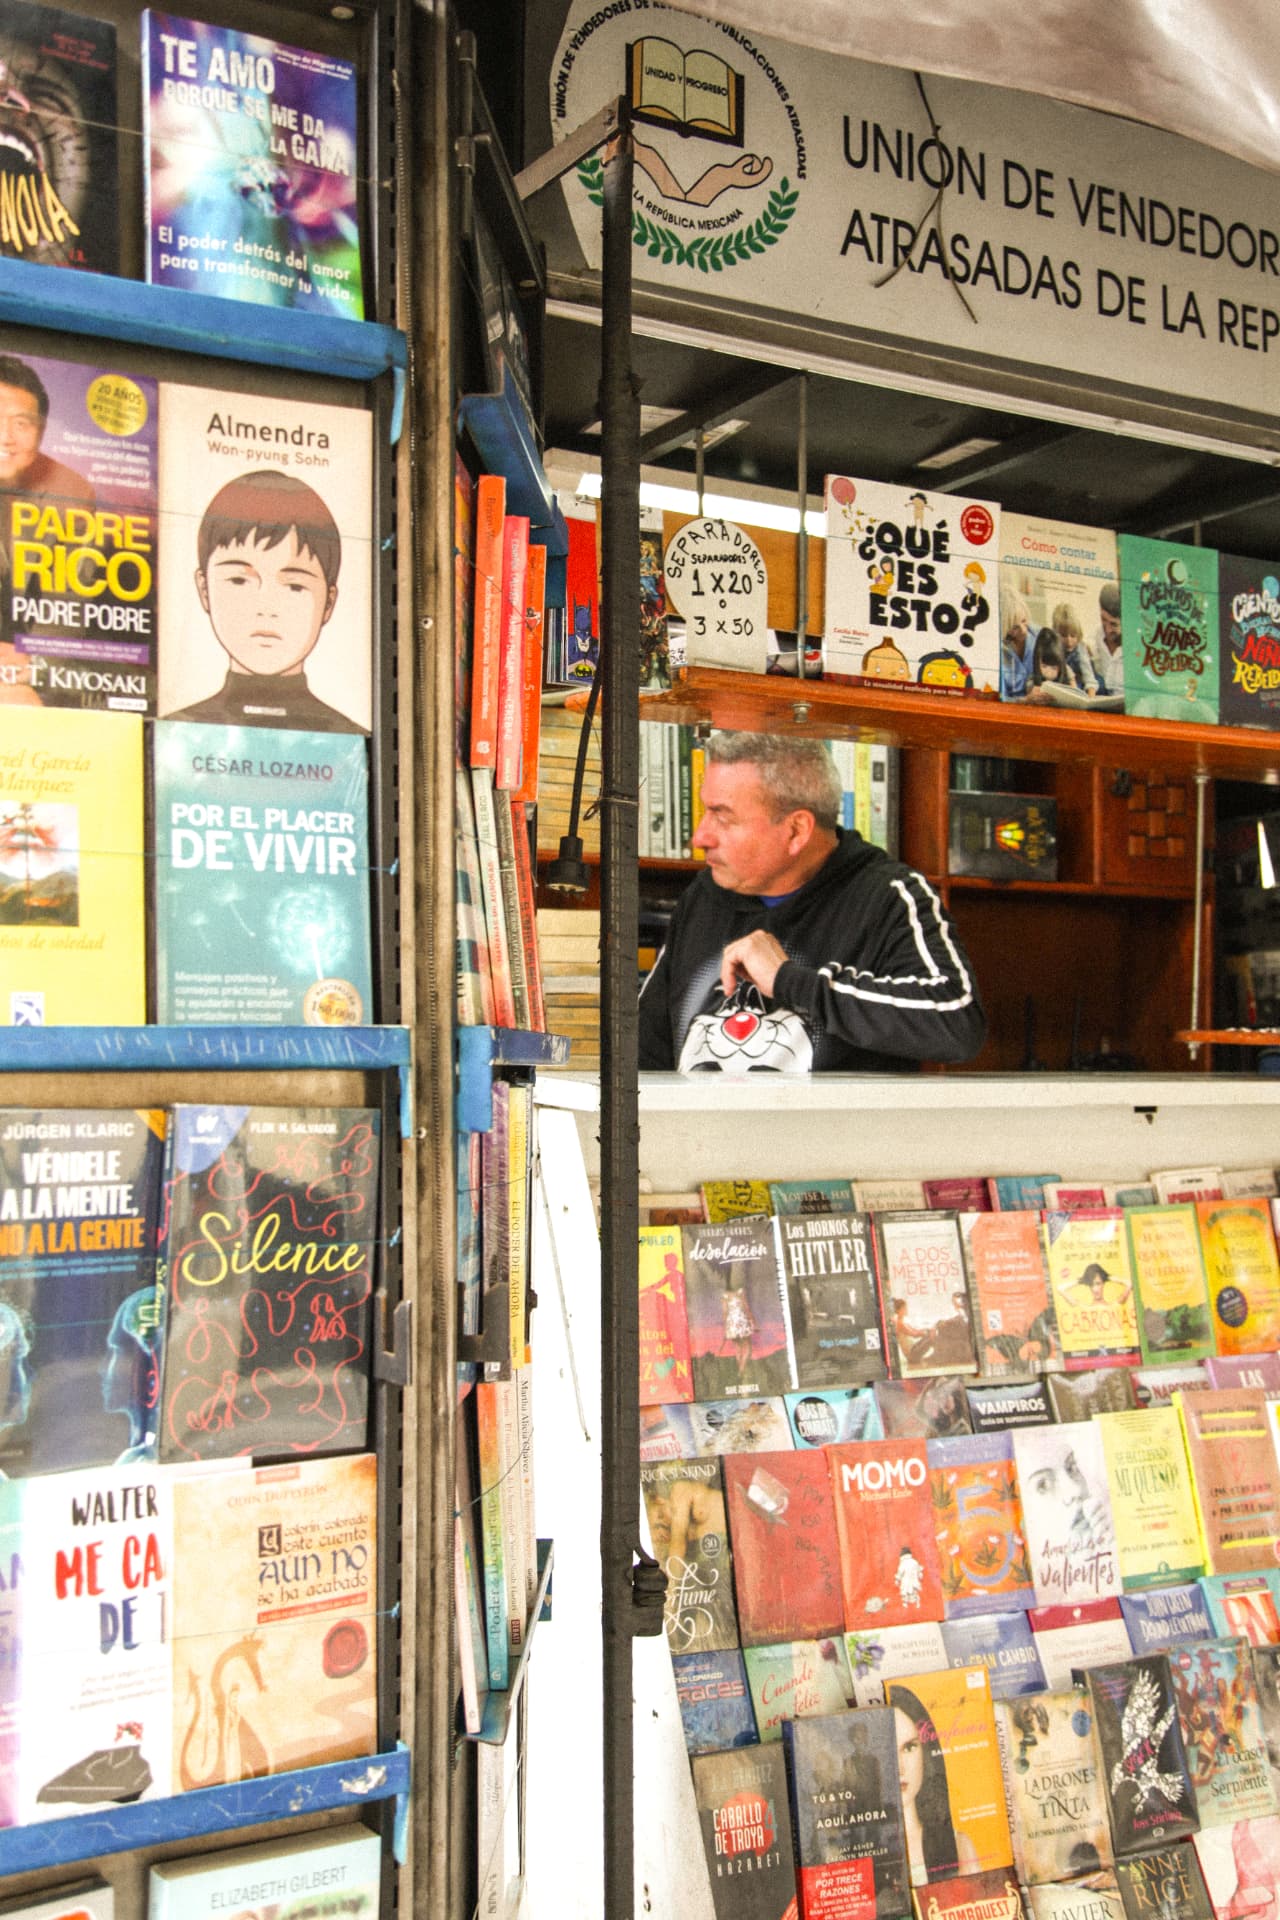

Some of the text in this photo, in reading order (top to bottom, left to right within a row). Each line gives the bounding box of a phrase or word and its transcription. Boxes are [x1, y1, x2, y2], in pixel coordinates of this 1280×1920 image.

[159, 33, 198, 78] TE
[207, 47, 276, 95] AMO
[555, 0, 632, 119] UNIÓN DE VENDEDORES
[644, 66, 676, 83] UNIDAD
[686, 77, 729, 97] PROGRESO
[162, 77, 325, 140] PORQUE SE ME DA
[269, 135, 288, 157] LA
[784, 104, 807, 180] ATRASADAS
[633, 189, 744, 231] LA REPÚBLICA MEXICANA
[1003, 158, 1280, 277] DE VENDEDOR
[158, 225, 351, 281] El poder detrás del amor
[160, 253, 199, 272] para
[203, 257, 295, 289] transformar
[298, 278, 312, 295] tu
[839, 208, 1280, 353] ATRASADAS DE LA REP
[206, 412, 331, 450] Almendra
[207, 439, 331, 468] Won-pyung Sohn
[11, 500, 152, 550] PADRE
[667, 522, 765, 584] SEPARADORES
[858, 519, 951, 564] ¿QUÉ
[1020, 536, 1097, 561] Cómo contar
[11, 541, 153, 601] RICO
[690, 553, 747, 565] SEPARADORES
[1003, 554, 1115, 581] cuentos a los niños
[691, 568, 705, 597] 1
[728, 570, 753, 595] 20
[896, 559, 939, 596] ES
[12, 595, 152, 634] PADRE POBRE
[693, 615, 707, 636] 3
[731, 617, 754, 636] 50
[868, 592, 990, 648] ESTO?
[1150, 621, 1202, 650] NIÑAS
[1141, 635, 1208, 677] REBELDES
[49, 665, 147, 695] KIYOSAKI
[1185, 678, 1198, 702] 2
[191, 754, 334, 782] CÉSAR LOZANO
[170, 802, 356, 835] POR EL PLACER
[170, 828, 357, 877] DE VIVIR
[2, 1121, 136, 1141] JÜRGEN KLARIC
[21, 1146, 122, 1185] VÉNDELE
[0, 1183, 140, 1221] A LA MENTE,
[27, 1222, 46, 1256] A
[47, 1221, 77, 1254] LA
[79, 1217, 146, 1252] GENTE
[785, 1218, 864, 1240] Los HORNOS de
[181, 1210, 367, 1287] Silence
[510, 1200, 522, 1319] EL PODER DEL AHORA
[688, 1236, 769, 1262] desolación
[787, 1237, 871, 1278] HITLER
[899, 1246, 951, 1263] A DOS
[892, 1261, 961, 1280] METROS
[905, 1278, 948, 1297] DE TI
[1059, 1310, 1138, 1335] CABRONAS
[1237, 1368, 1265, 1388] LAS
[520, 1380, 532, 1411] Martha
[975, 1396, 1048, 1416] VAMPIROS
[520, 1412, 531, 1438] Alicia
[520, 1440, 533, 1475] Chávez
[840, 1457, 927, 1493] MOMO
[71, 1484, 159, 1527] WALTER
[323, 1512, 369, 1531] colorado
[282, 1527, 368, 1554] este cuento
[54, 1532, 168, 1600] ME CA
[279, 1585, 300, 1607] ha
[305, 1572, 369, 1597] acabado
[99, 1595, 142, 1655] DE
[487, 1590, 502, 1633] Poder
[999, 1645, 1037, 1667] CAMBIO
[760, 1661, 815, 1705] Cuando
[794, 1690, 822, 1716] feliz
[1231, 1746, 1264, 1763] ocaso
[812, 1792, 826, 1804] TÚ
[1023, 1767, 1097, 1799] LADRONES
[1210, 1771, 1270, 1798] Serpiente
[712, 1802, 762, 1832] CABALLO
[849, 1810, 888, 1824] AHORA
[1038, 1798, 1091, 1821] TINTA
[714, 1825, 765, 1856] DE TROYA
[857, 1847, 889, 1859] MACKLER
[716, 1851, 782, 1878] NAZARET
[1128, 1850, 1187, 1882] ANNE
[210, 1864, 348, 1911] ELIZABETH GILBERT
[814, 1872, 863, 1889] POR TRECE
[819, 1884, 862, 1899] RAZONES
[1131, 1872, 1196, 1911] RICE
